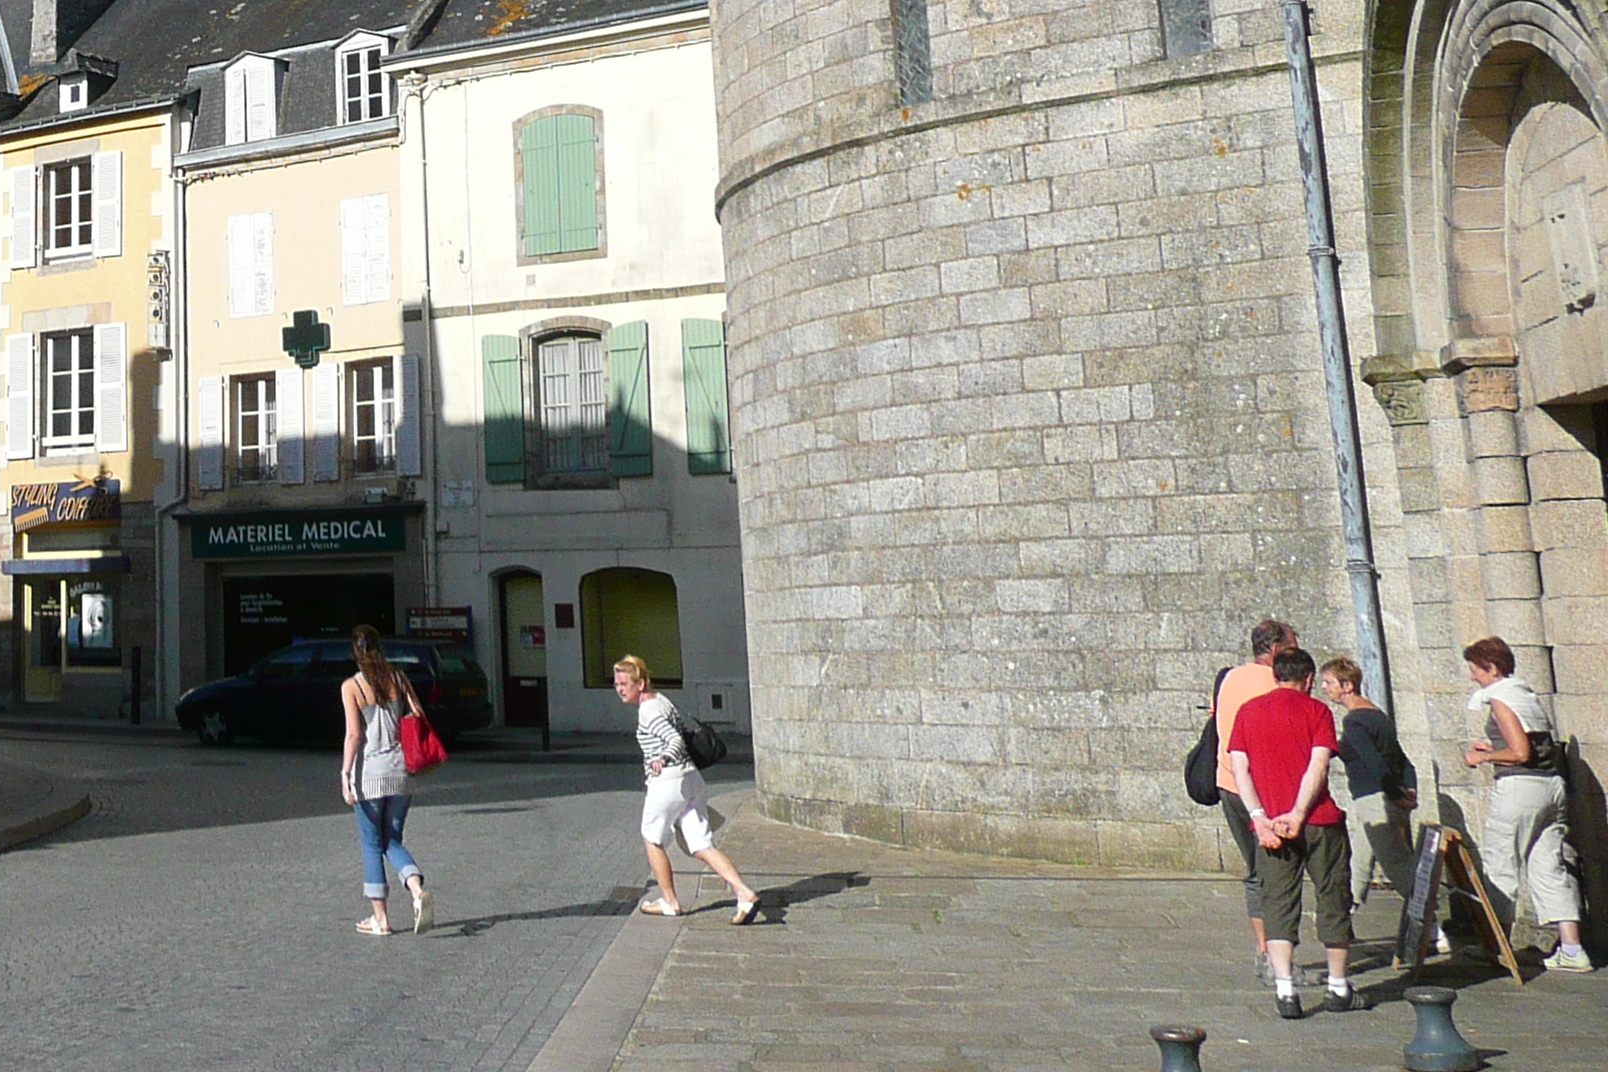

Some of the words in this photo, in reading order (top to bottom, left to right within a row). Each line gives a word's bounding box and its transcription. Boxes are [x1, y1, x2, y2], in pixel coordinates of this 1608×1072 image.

[12, 483, 59, 511] STYLING
[208, 524, 292, 545] MATERIEL
[301, 519, 387, 541] MEDICAL
[250, 541, 293, 552] Location
[296, 539, 307, 550] et
[311, 541, 340, 551] Vente
